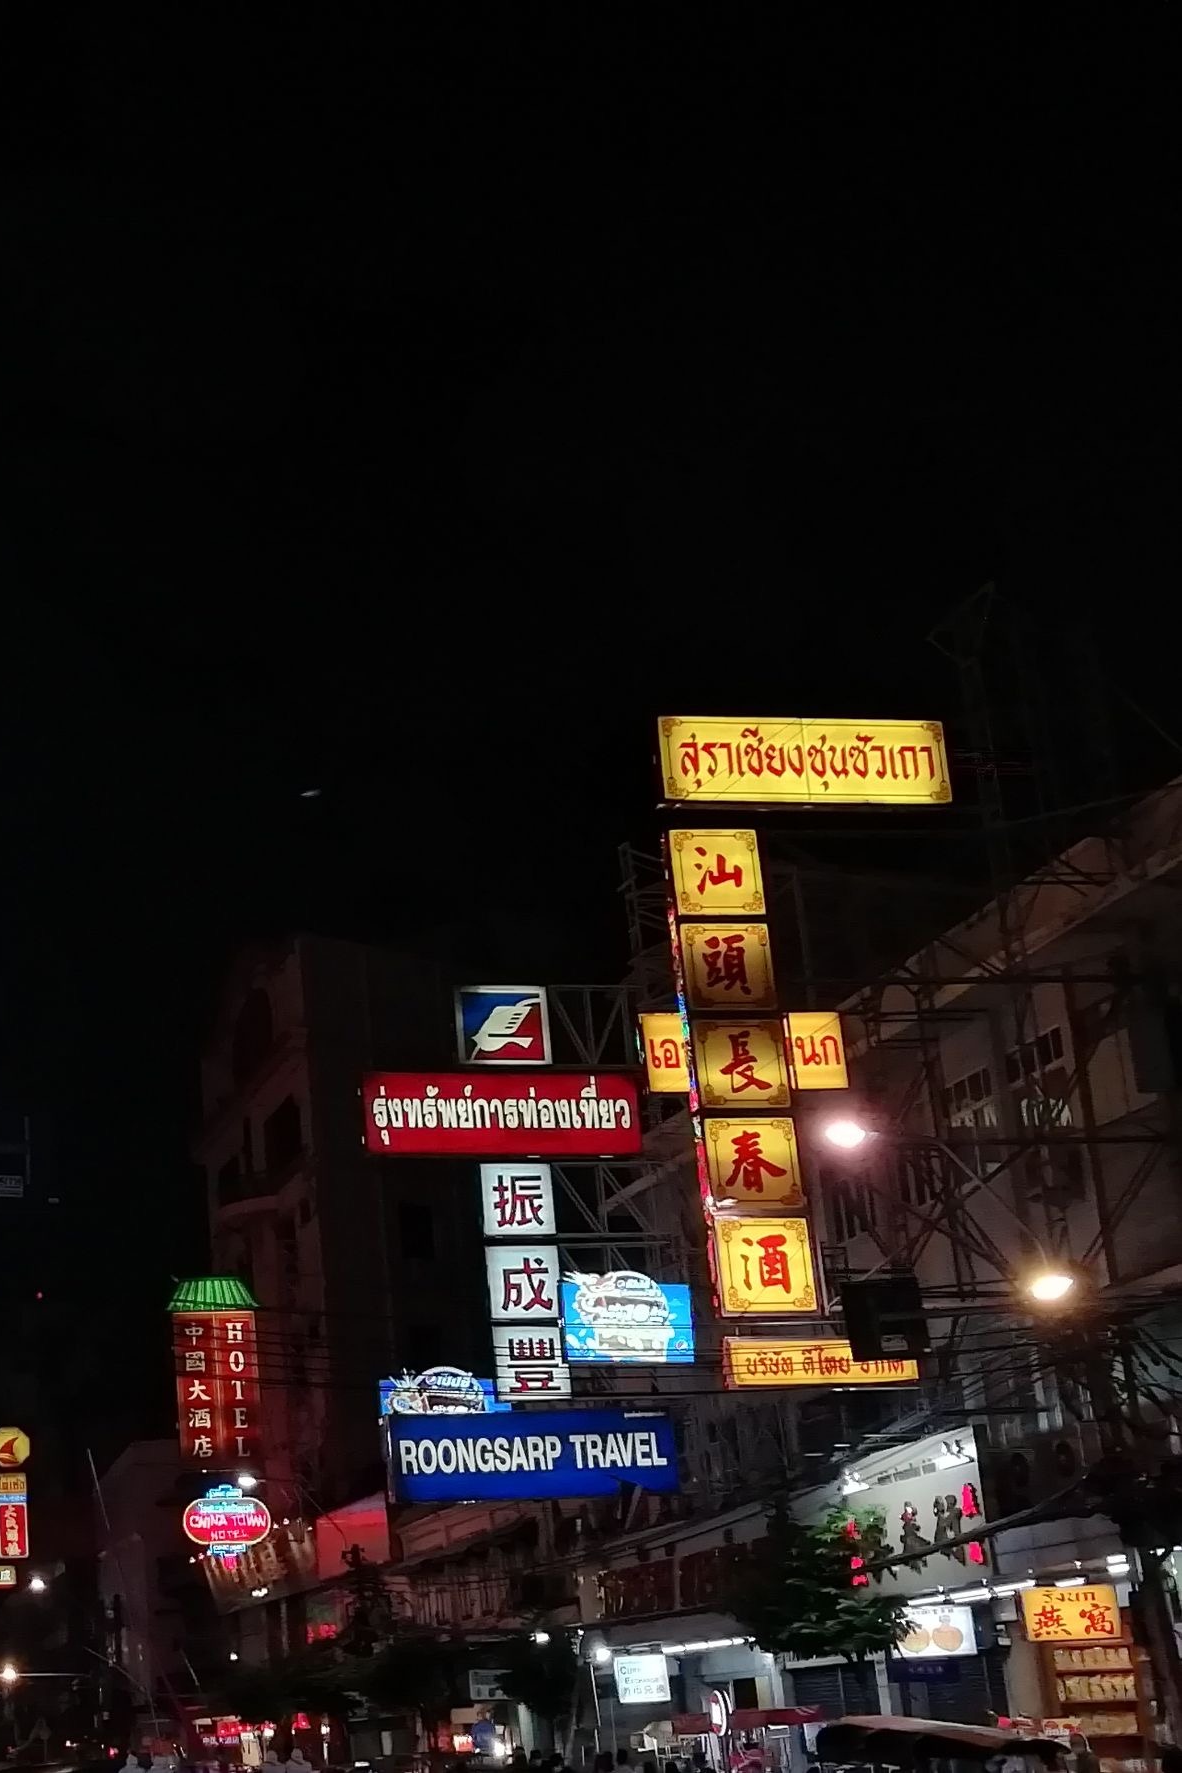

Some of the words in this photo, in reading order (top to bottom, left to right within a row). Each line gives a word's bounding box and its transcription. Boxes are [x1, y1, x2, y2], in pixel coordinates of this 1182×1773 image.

[694, 846, 791, 1294] 汕頭長春酒
[373, 1075, 630, 1145] รุ่งทรัพย์การท่องเที่ยว
[225, 1322, 251, 1457] HOTEL
[400, 1435, 561, 1475] ROONGSARP
[569, 1432, 668, 1469] TRAVEL
[1033, 1603, 1114, 1638] 燕窩
